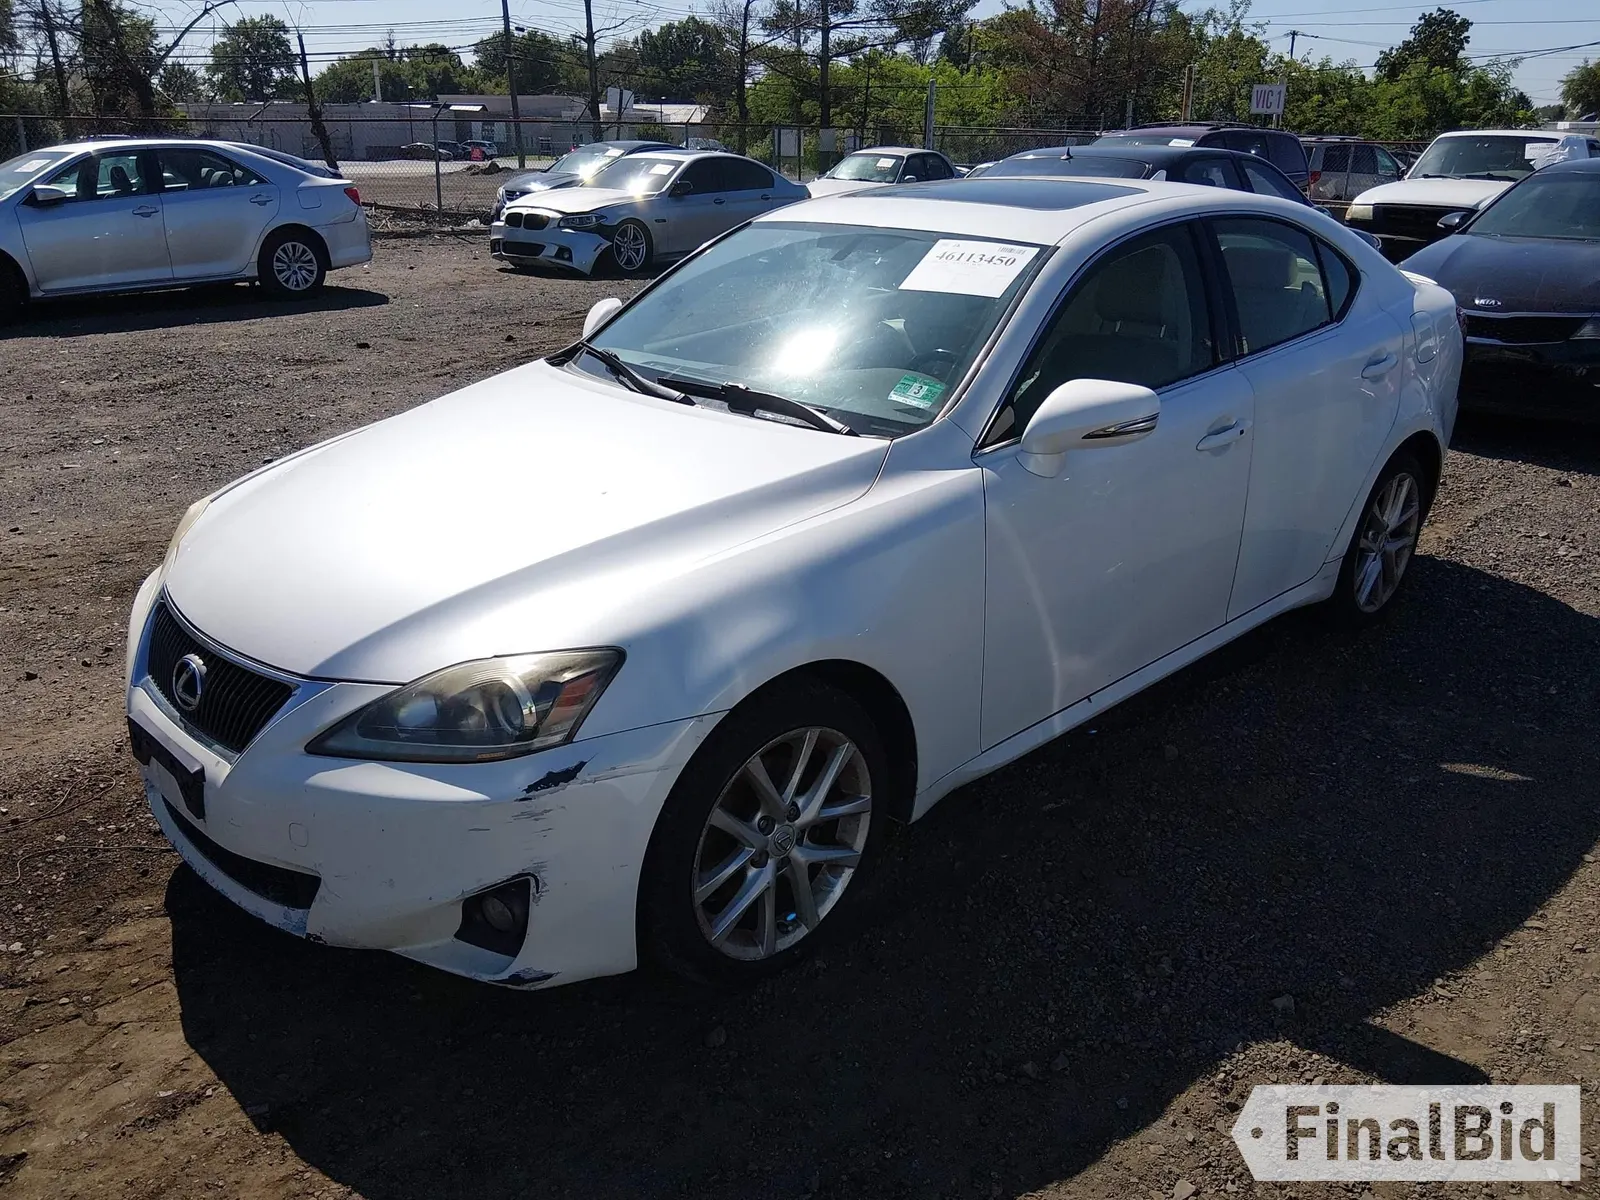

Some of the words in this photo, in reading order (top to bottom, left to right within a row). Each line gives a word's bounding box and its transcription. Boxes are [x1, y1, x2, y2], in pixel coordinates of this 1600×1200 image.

[1255, 90, 1274, 109] VIC
[1276, 90, 1282, 109] 1
[935, 251, 1017, 267] 46113450
[913, 385, 923, 394] 3
